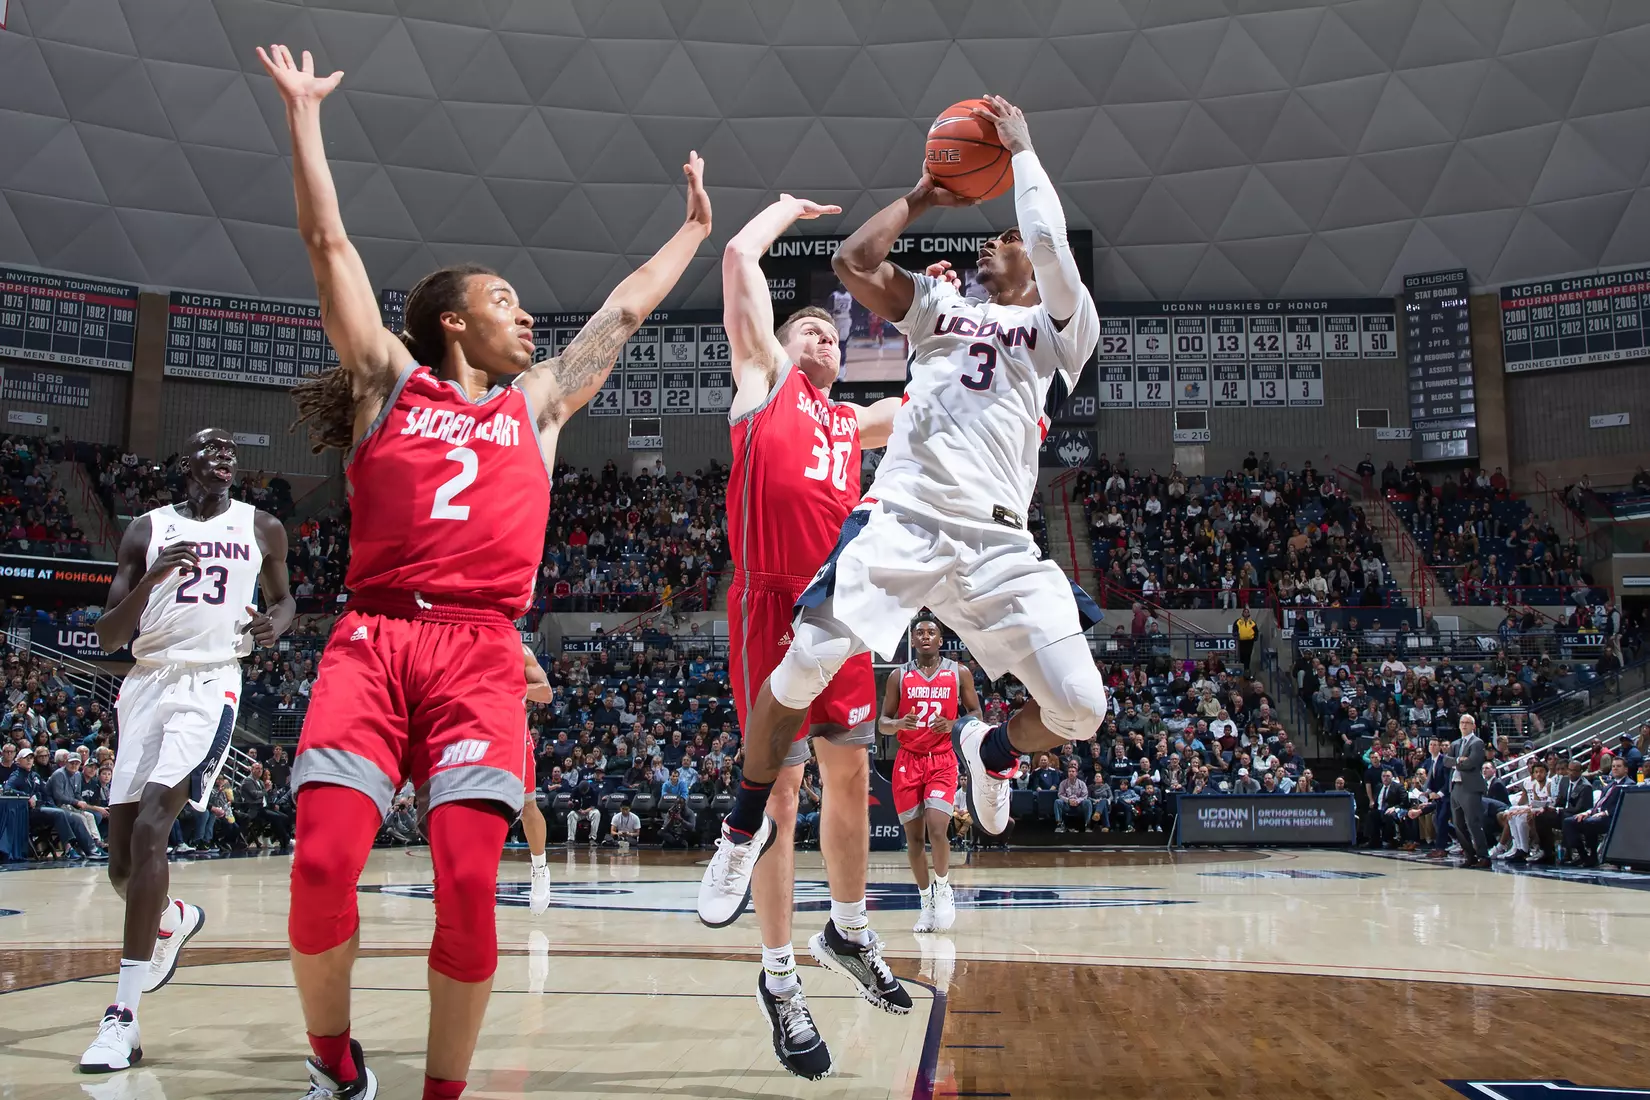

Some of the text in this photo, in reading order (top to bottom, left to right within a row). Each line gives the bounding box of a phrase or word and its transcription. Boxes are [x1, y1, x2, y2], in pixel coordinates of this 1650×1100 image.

[890, 238, 915, 254] OF
[6, 272, 130, 296] INVITATION TOURNAMENT
[1406, 272, 1464, 287] GO HUSKIES
[0, 282, 86, 301] APPEARANCES
[1414, 287, 1458, 300] STAT BOARD
[1511, 283, 1553, 297] NCAA
[3, 294, 23, 308] 1975
[59, 301, 78, 315] 1981
[86, 305, 106, 319] 1982
[181, 295, 222, 307] NCAA
[1162, 301, 1328, 312] UCONN HUSKIES OF HONOR
[1511, 290, 1591, 308] TOURNAMENT
[179, 306, 256, 321] TOURNAMENT
[1505, 309, 1527, 324] 2000
[1532, 306, 1553, 320] 2002
[1560, 302, 1581, 317] 2003
[1586, 299, 1609, 313] 2004
[1614, 295, 1637, 310] 2005
[1, 312, 105, 337] 1997 2001 2010 2015
[173, 315, 322, 342] 1951 1954 1956 1957 1958 1959
[933, 313, 1038, 351] UCONN
[1506, 314, 1637, 342] 2009 2011 2012 2014 2016
[171, 333, 320, 360] 1963 1964 1965 1967 1976 1979
[1102, 337, 1128, 353] 52
[1178, 336, 1203, 352] 00
[1217, 335, 1239, 352] 13
[1253, 335, 1279, 351] 42
[1296, 334, 1312, 351] 34
[1334, 333, 1349, 350] 32
[1371, 333, 1387, 350] 50
[23, 350, 127, 370] MEN'S BASKETBALL
[630, 343, 656, 361] 44
[703, 343, 729, 360] 42
[1424, 352, 1455, 362] REBOUNDS
[170, 351, 293, 375] 1991 1992 1994 1995 1996
[960, 342, 998, 391] 3
[1511, 351, 1621, 371] CONNECTICUT MEN'S
[32, 372, 64, 384] 1988
[170, 367, 276, 384] CONNECTICUT MEN'S
[1429, 365, 1453, 375] ASSISTS
[4, 379, 90, 397] NATIONAL INVITATION
[1109, 383, 1123, 400] 15
[1146, 383, 1161, 400] 22
[1222, 382, 1238, 399] 42
[1259, 381, 1276, 399] 13
[1302, 381, 1309, 398] 3
[1425, 378, 1458, 388] TURNOVERS
[4, 389, 89, 407] TOURNAMENT CHAMPION
[593, 390, 618, 408] 24
[632, 390, 652, 407] 13
[666, 390, 690, 407] 22
[1431, 392, 1454, 401] BLOCKS
[797, 391, 830, 428] SAC
[1432, 406, 1454, 415] STEALS
[9, 413, 43, 424] SEC 5
[401, 406, 476, 446] SACRED
[1617, 414, 1625, 424] 7
[258, 435, 265, 444] 6
[1174, 431, 1210, 440] SEC 216
[1395, 429, 1413, 438] 217
[1422, 429, 1467, 441] TIME OF DAY
[644, 438, 663, 447] 214
[804, 427, 853, 492] 30
[430, 447, 479, 521] 2
[158, 541, 250, 561] ONN
[37, 569, 54, 580] AT
[55, 571, 112, 584] MOHEGAN
[175, 565, 229, 606] 23
[583, 641, 603, 652] 114
[1216, 639, 1236, 650] 116
[1319, 638, 1340, 648] 117
[1584, 635, 1605, 645] 117
[907, 686, 951, 700] SACRED HEART
[916, 701, 943, 728] 22
[1198, 807, 1249, 820] UCONN
[1258, 809, 1317, 818] ORTHOPEDICS
[1258, 818, 1334, 827] SPORTS MEDICINE
